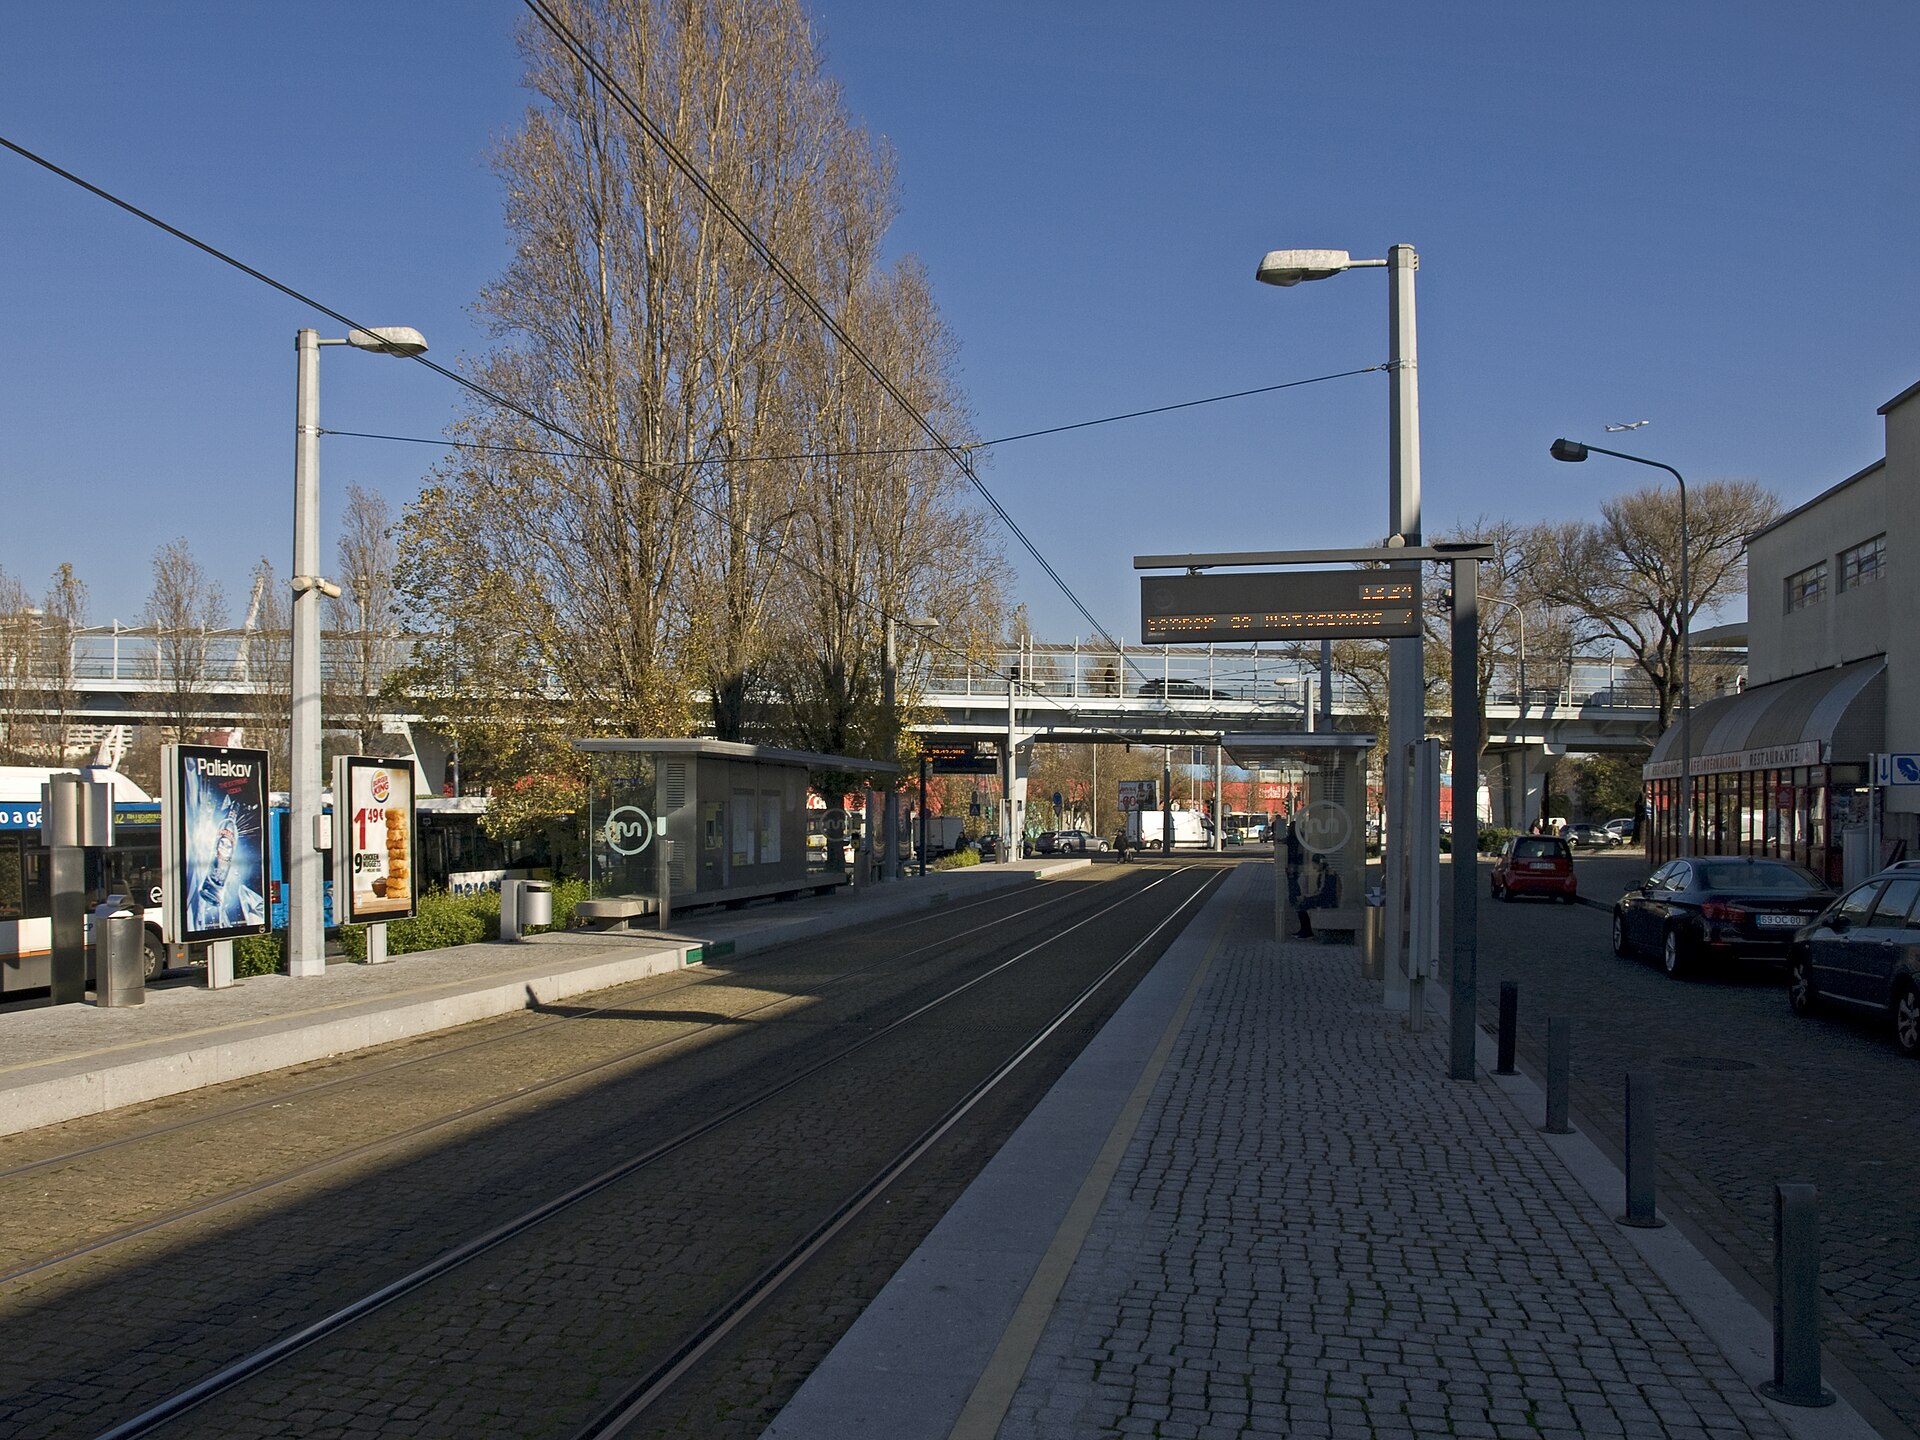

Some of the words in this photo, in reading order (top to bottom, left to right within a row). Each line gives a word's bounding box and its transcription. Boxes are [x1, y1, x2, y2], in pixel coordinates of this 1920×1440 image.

[1749, 748, 1799, 767] RESTAURANTE
[197, 758, 252, 778] Poliakov
[374, 782, 389, 794] KING
